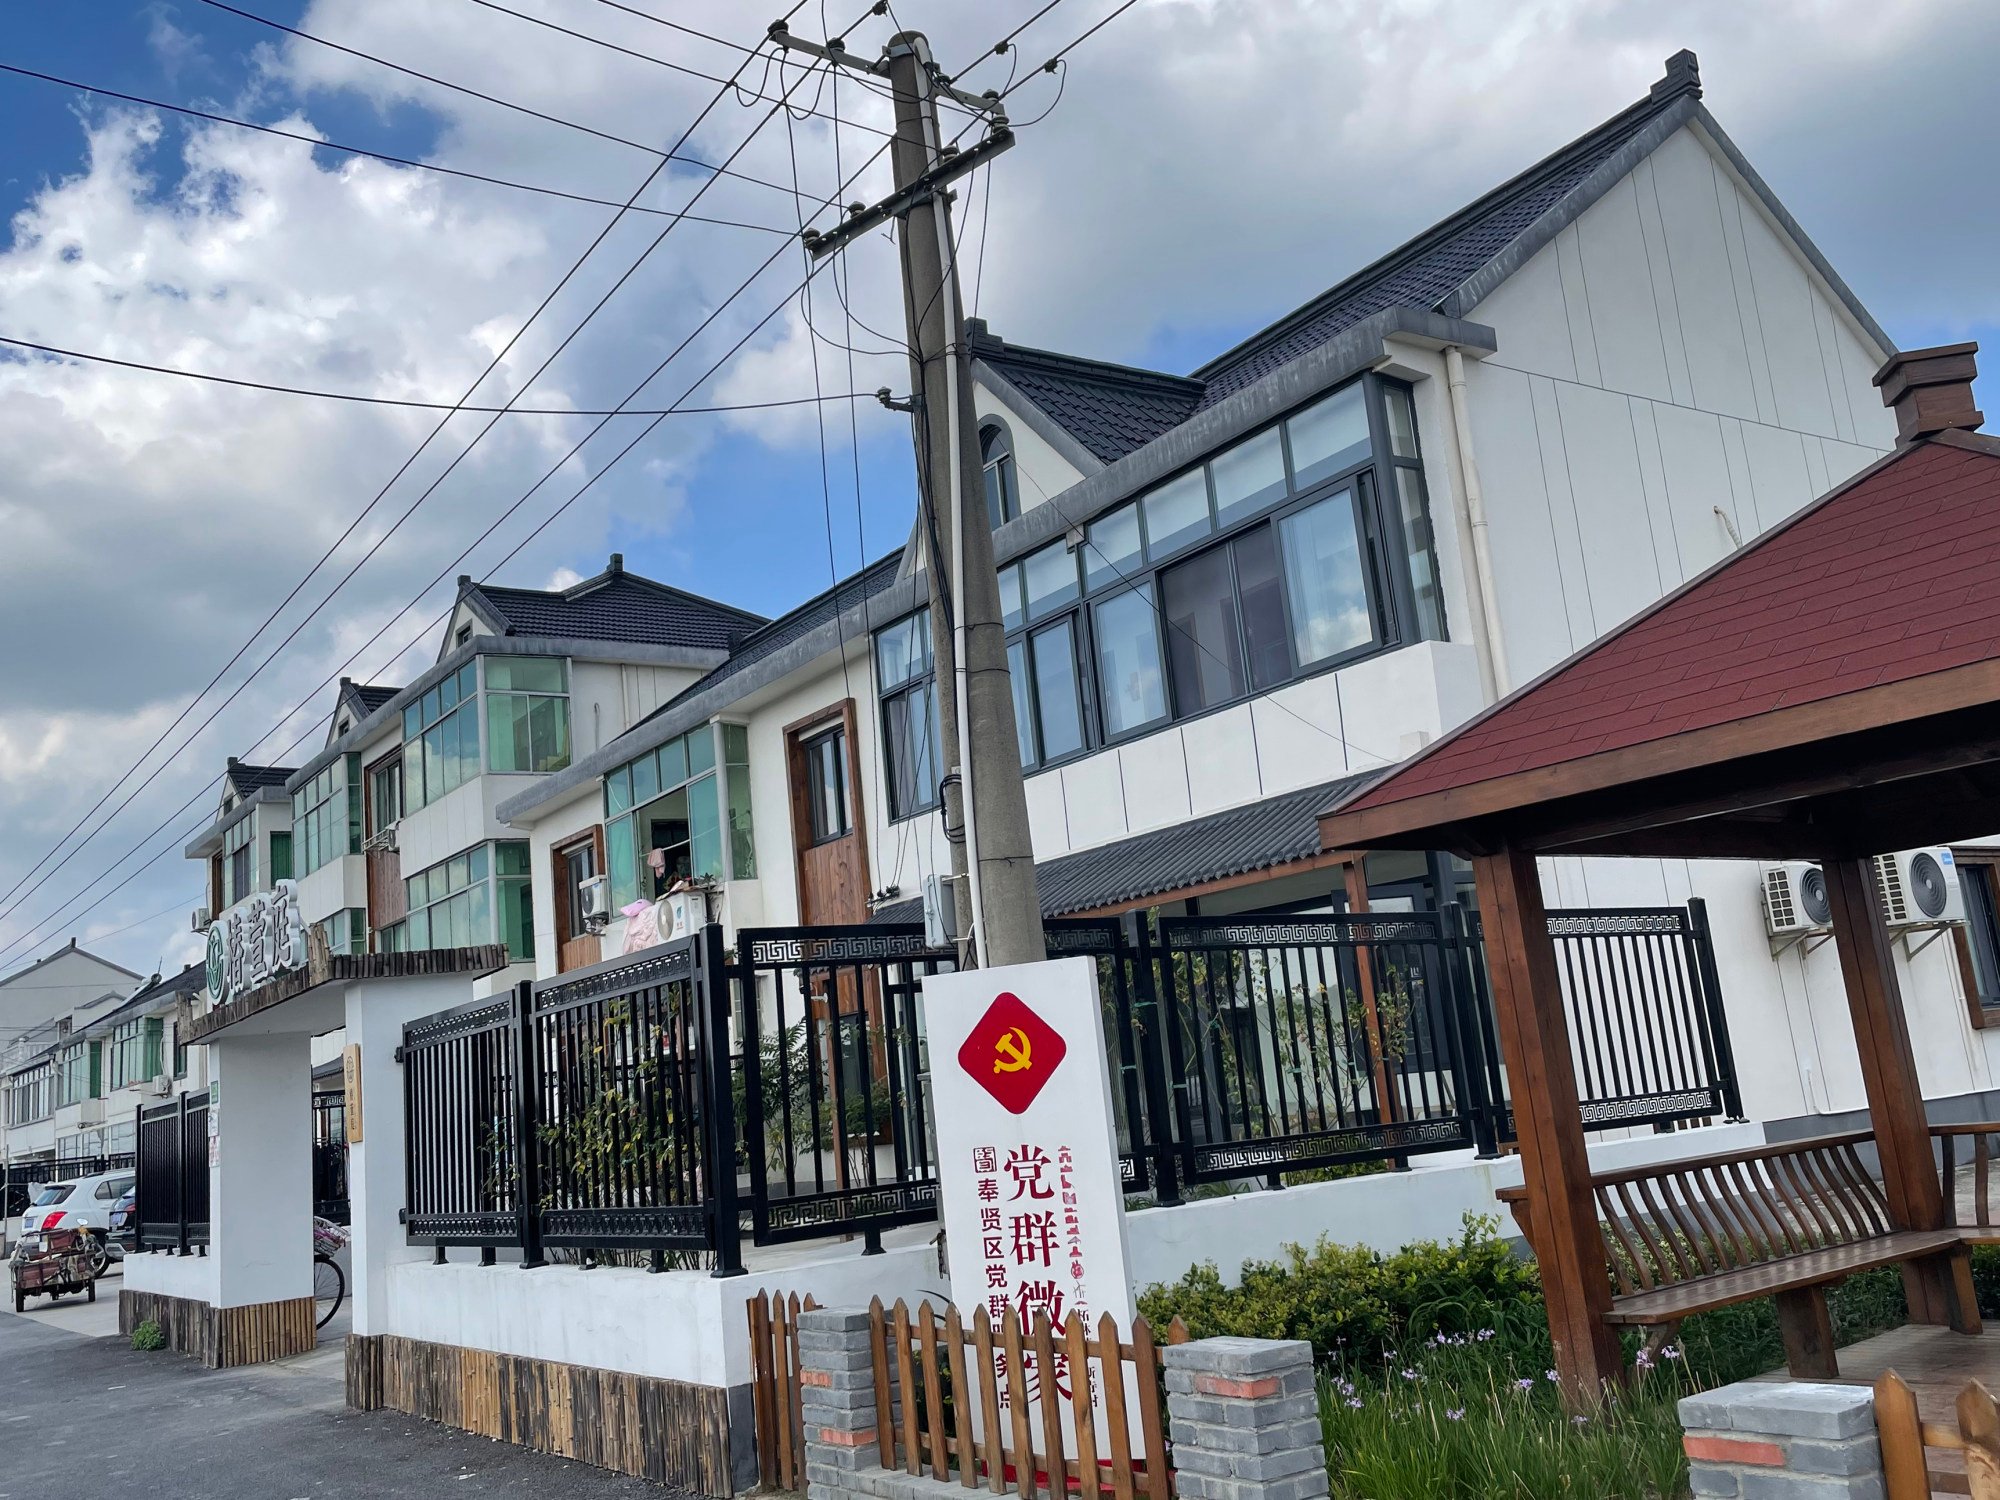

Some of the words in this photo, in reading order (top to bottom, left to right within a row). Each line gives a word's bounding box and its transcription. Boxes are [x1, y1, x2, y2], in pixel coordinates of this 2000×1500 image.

[977, 1177, 1012, 1409] 奉贤区党群务点
